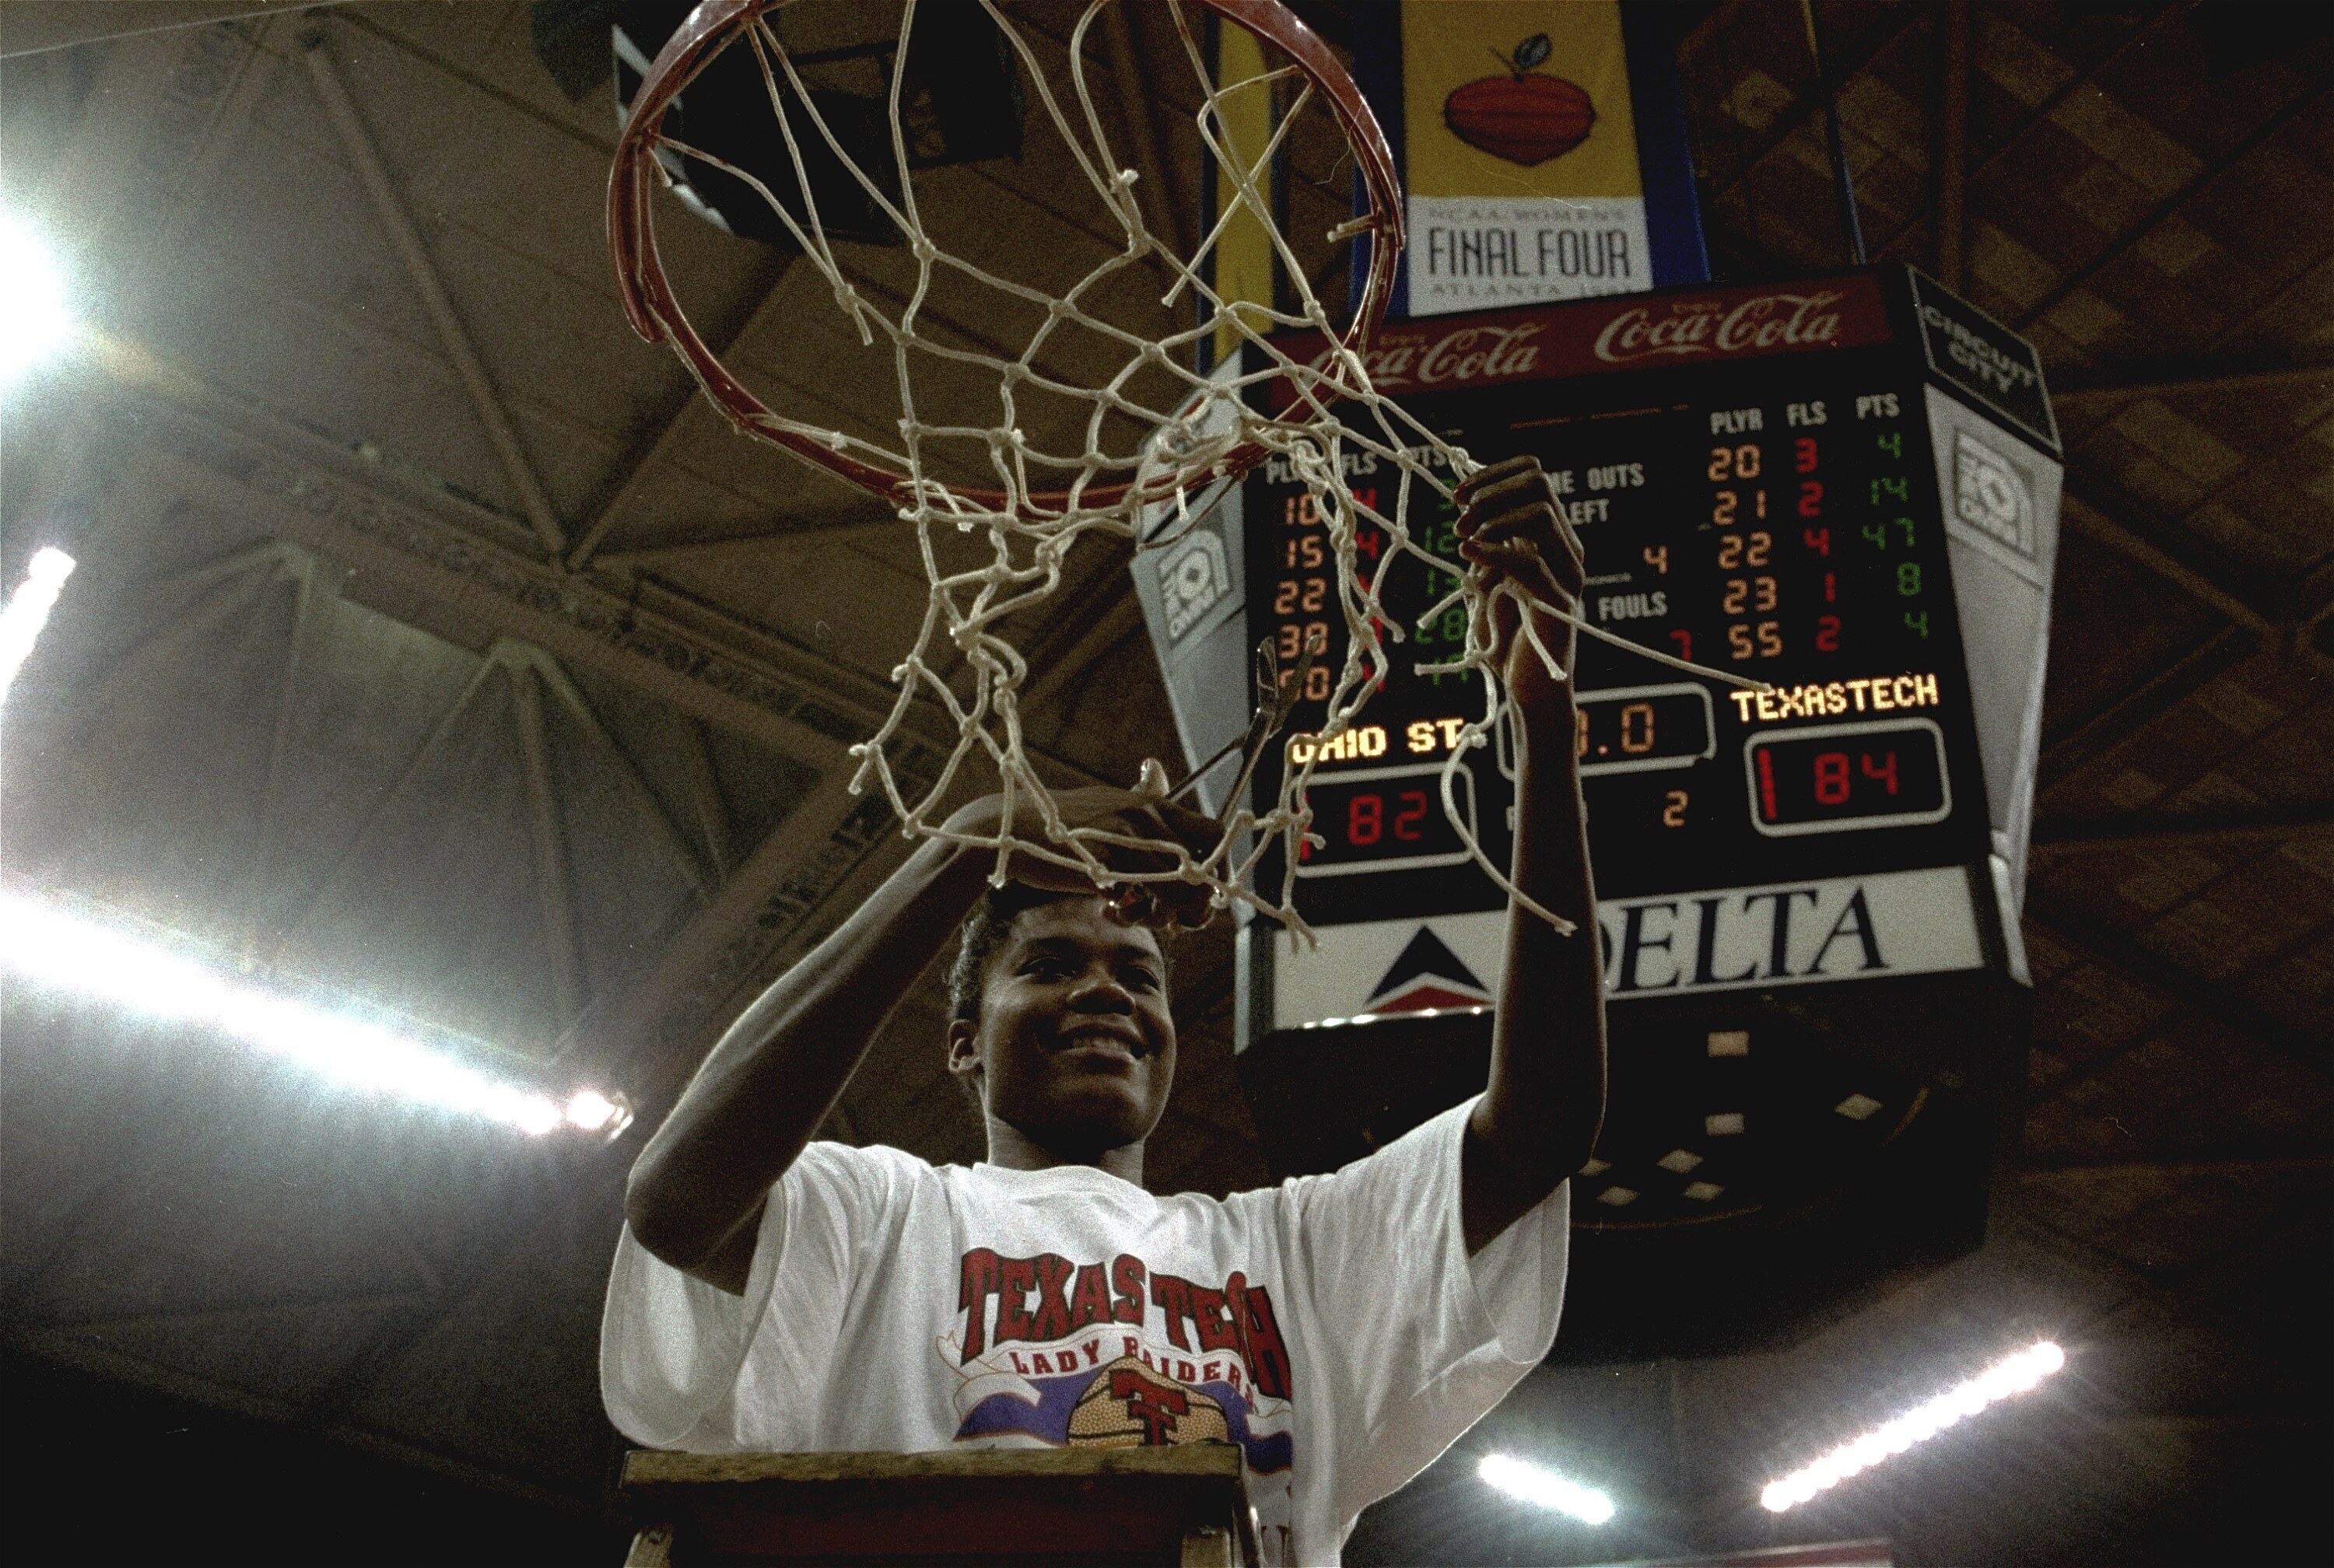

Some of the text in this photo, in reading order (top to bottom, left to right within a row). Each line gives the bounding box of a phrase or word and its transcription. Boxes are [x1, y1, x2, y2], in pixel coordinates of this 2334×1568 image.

[1428, 226, 1631, 278] FINAL FOUR
[1430, 282, 1561, 297] ATLANTA
[1593, 290, 1848, 363] Coca-Cola
[1923, 305, 2036, 388] CIRCUIT
[1947, 337, 2013, 394] CITY
[1711, 393, 1900, 436] PLYR FLS PTS
[1587, 462, 1645, 492] OUTS
[1708, 432, 1902, 481] 20 3 4
[1284, 492, 1320, 527] 10
[1712, 476, 1908, 526] 21 2 14
[1284, 534, 1323, 569] 15
[1642, 545, 1668, 574] 4
[1718, 516, 1915, 569] 22 4 47
[1274, 578, 1326, 615] 22
[1598, 591, 1668, 622] FOULS
[1722, 562, 1922, 615] 23 1 8
[1728, 610, 1929, 660] 55 2 4
[1292, 725, 1388, 765] OHIO
[1662, 789, 1691, 829] 2
[1600, 885, 1891, 995] ELTA
[958, 1246, 1149, 1367] TEXAS
[1009, 1337, 1103, 1376] LADY
